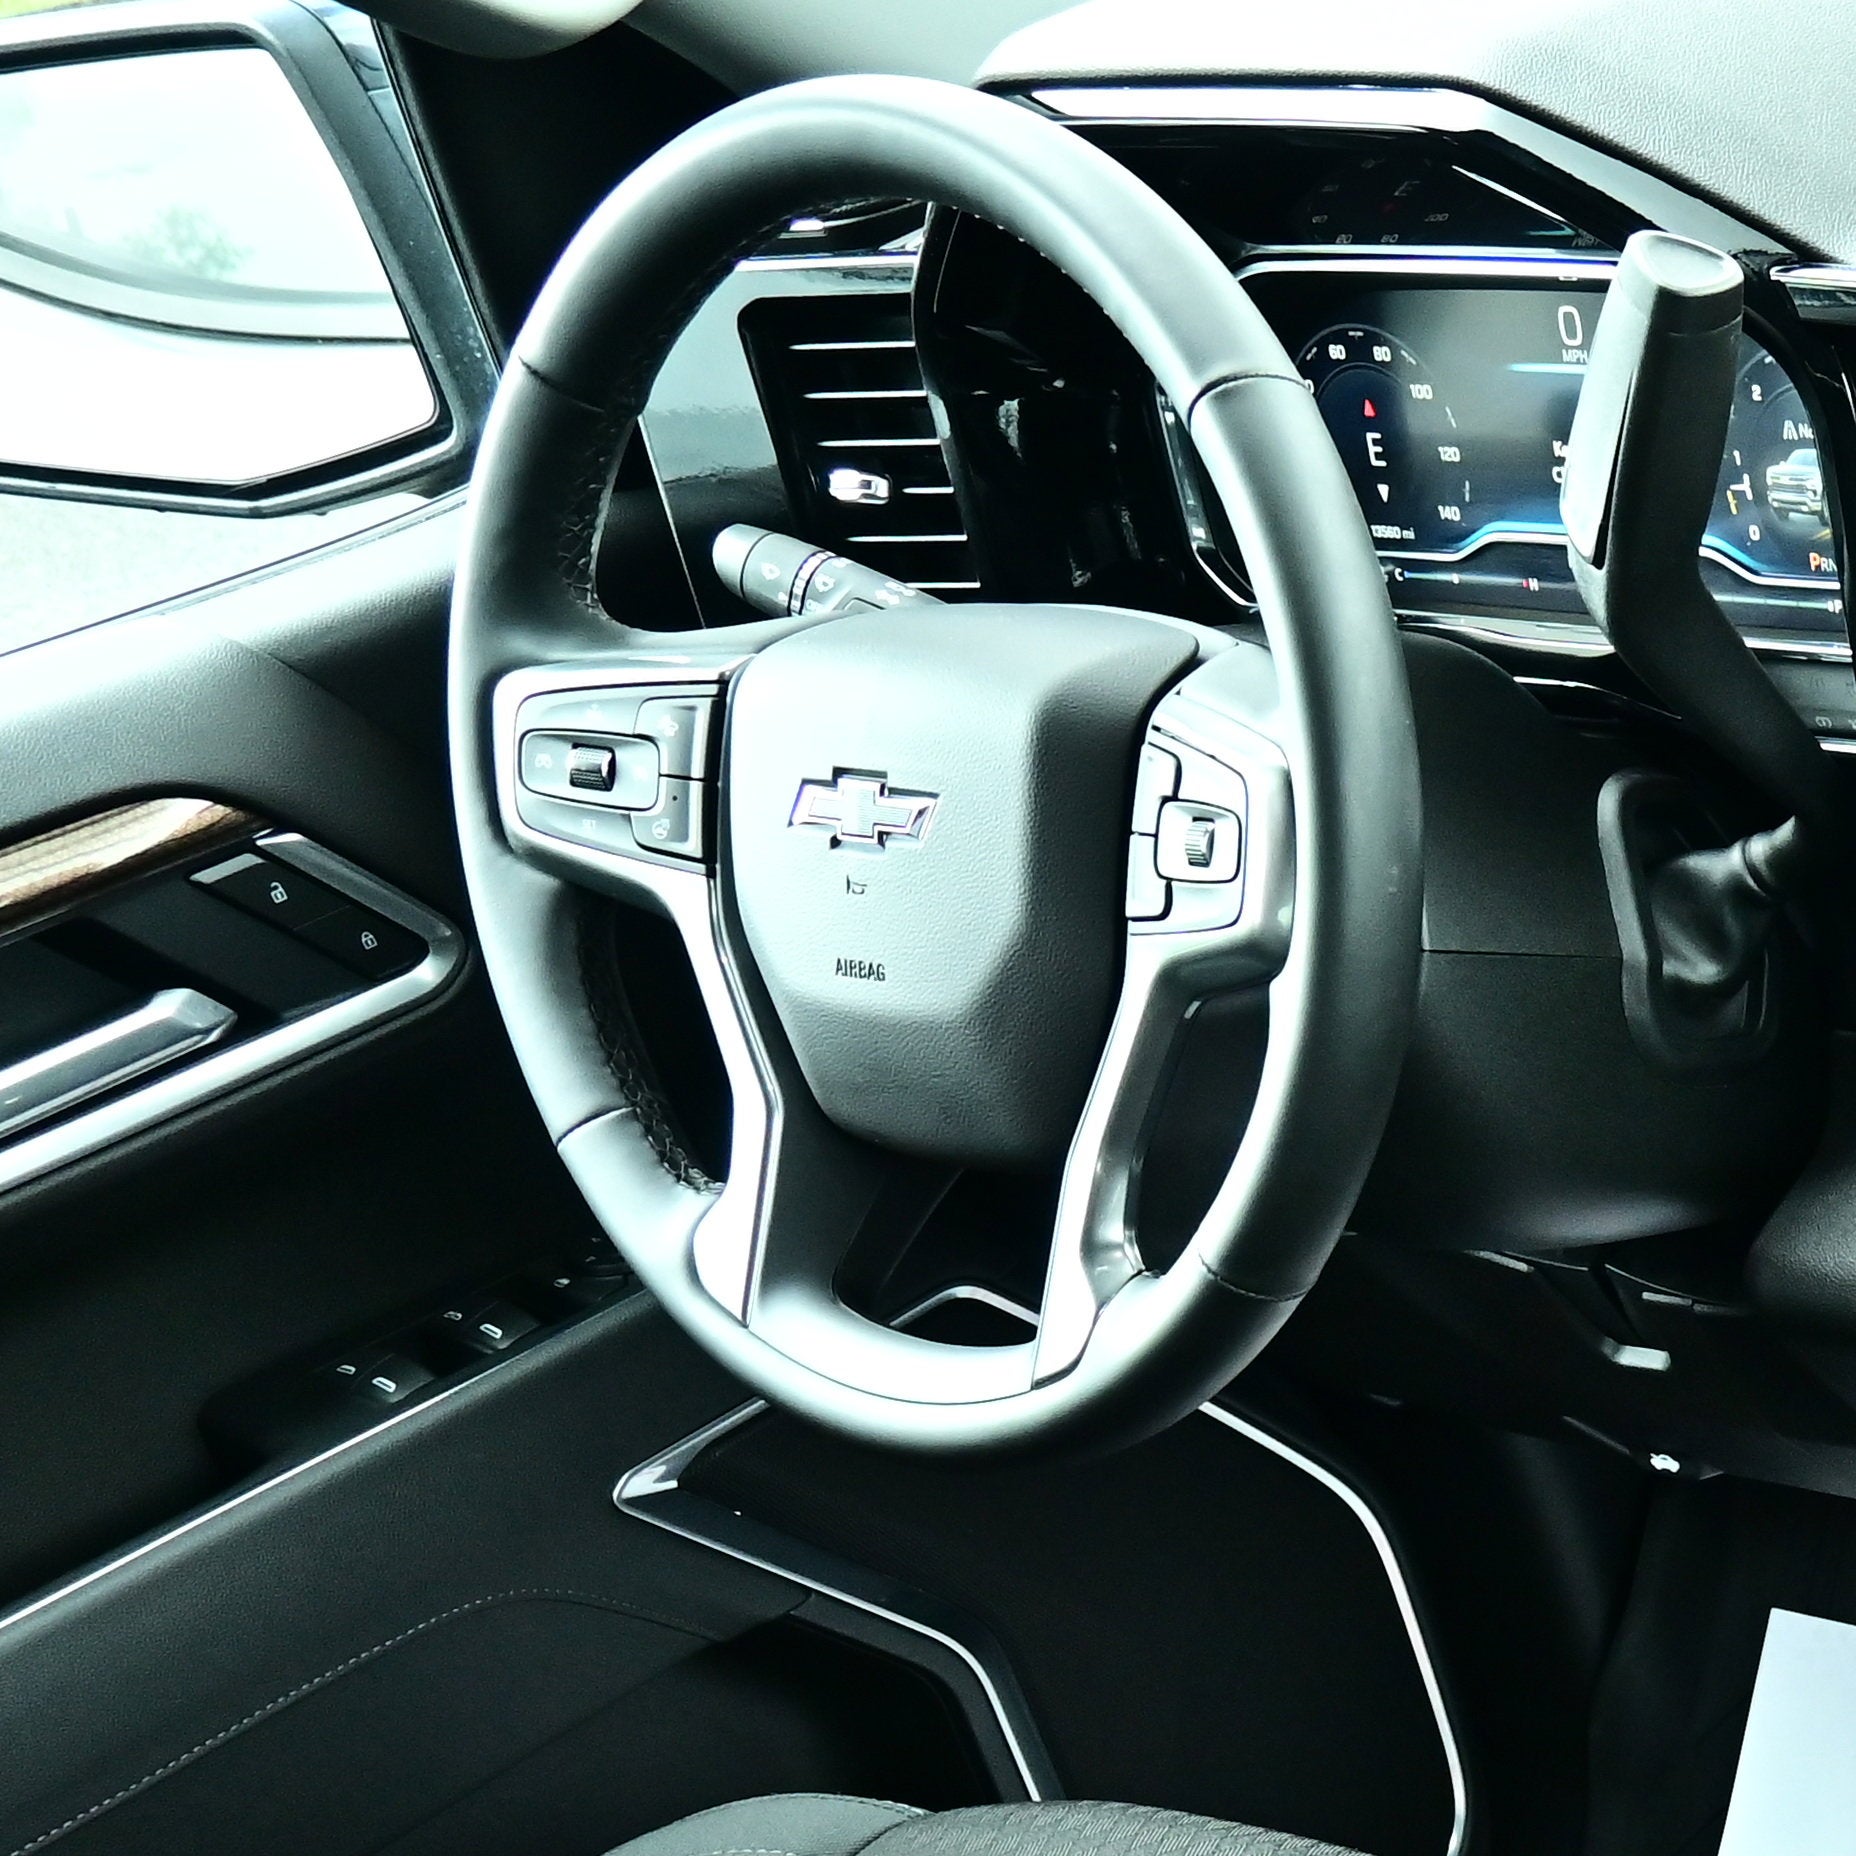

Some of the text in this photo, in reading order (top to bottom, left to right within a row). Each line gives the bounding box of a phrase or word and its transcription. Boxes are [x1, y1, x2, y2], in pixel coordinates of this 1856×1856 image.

[1557, 305, 1583, 347] 0
[1328, 344, 1347, 360] 60
[1372, 345, 1392, 362] 80
[1562, 349, 1588, 363] MPH
[1410, 384, 1433, 400] 100
[1751, 385, 1762, 401] 2
[1366, 432, 1387, 467] E
[1438, 447, 1461, 463] 120
[1438, 505, 1461, 522] 140
[1749, 525, 1760, 541] 0
[835, 956, 886, 982] AIRBAG
